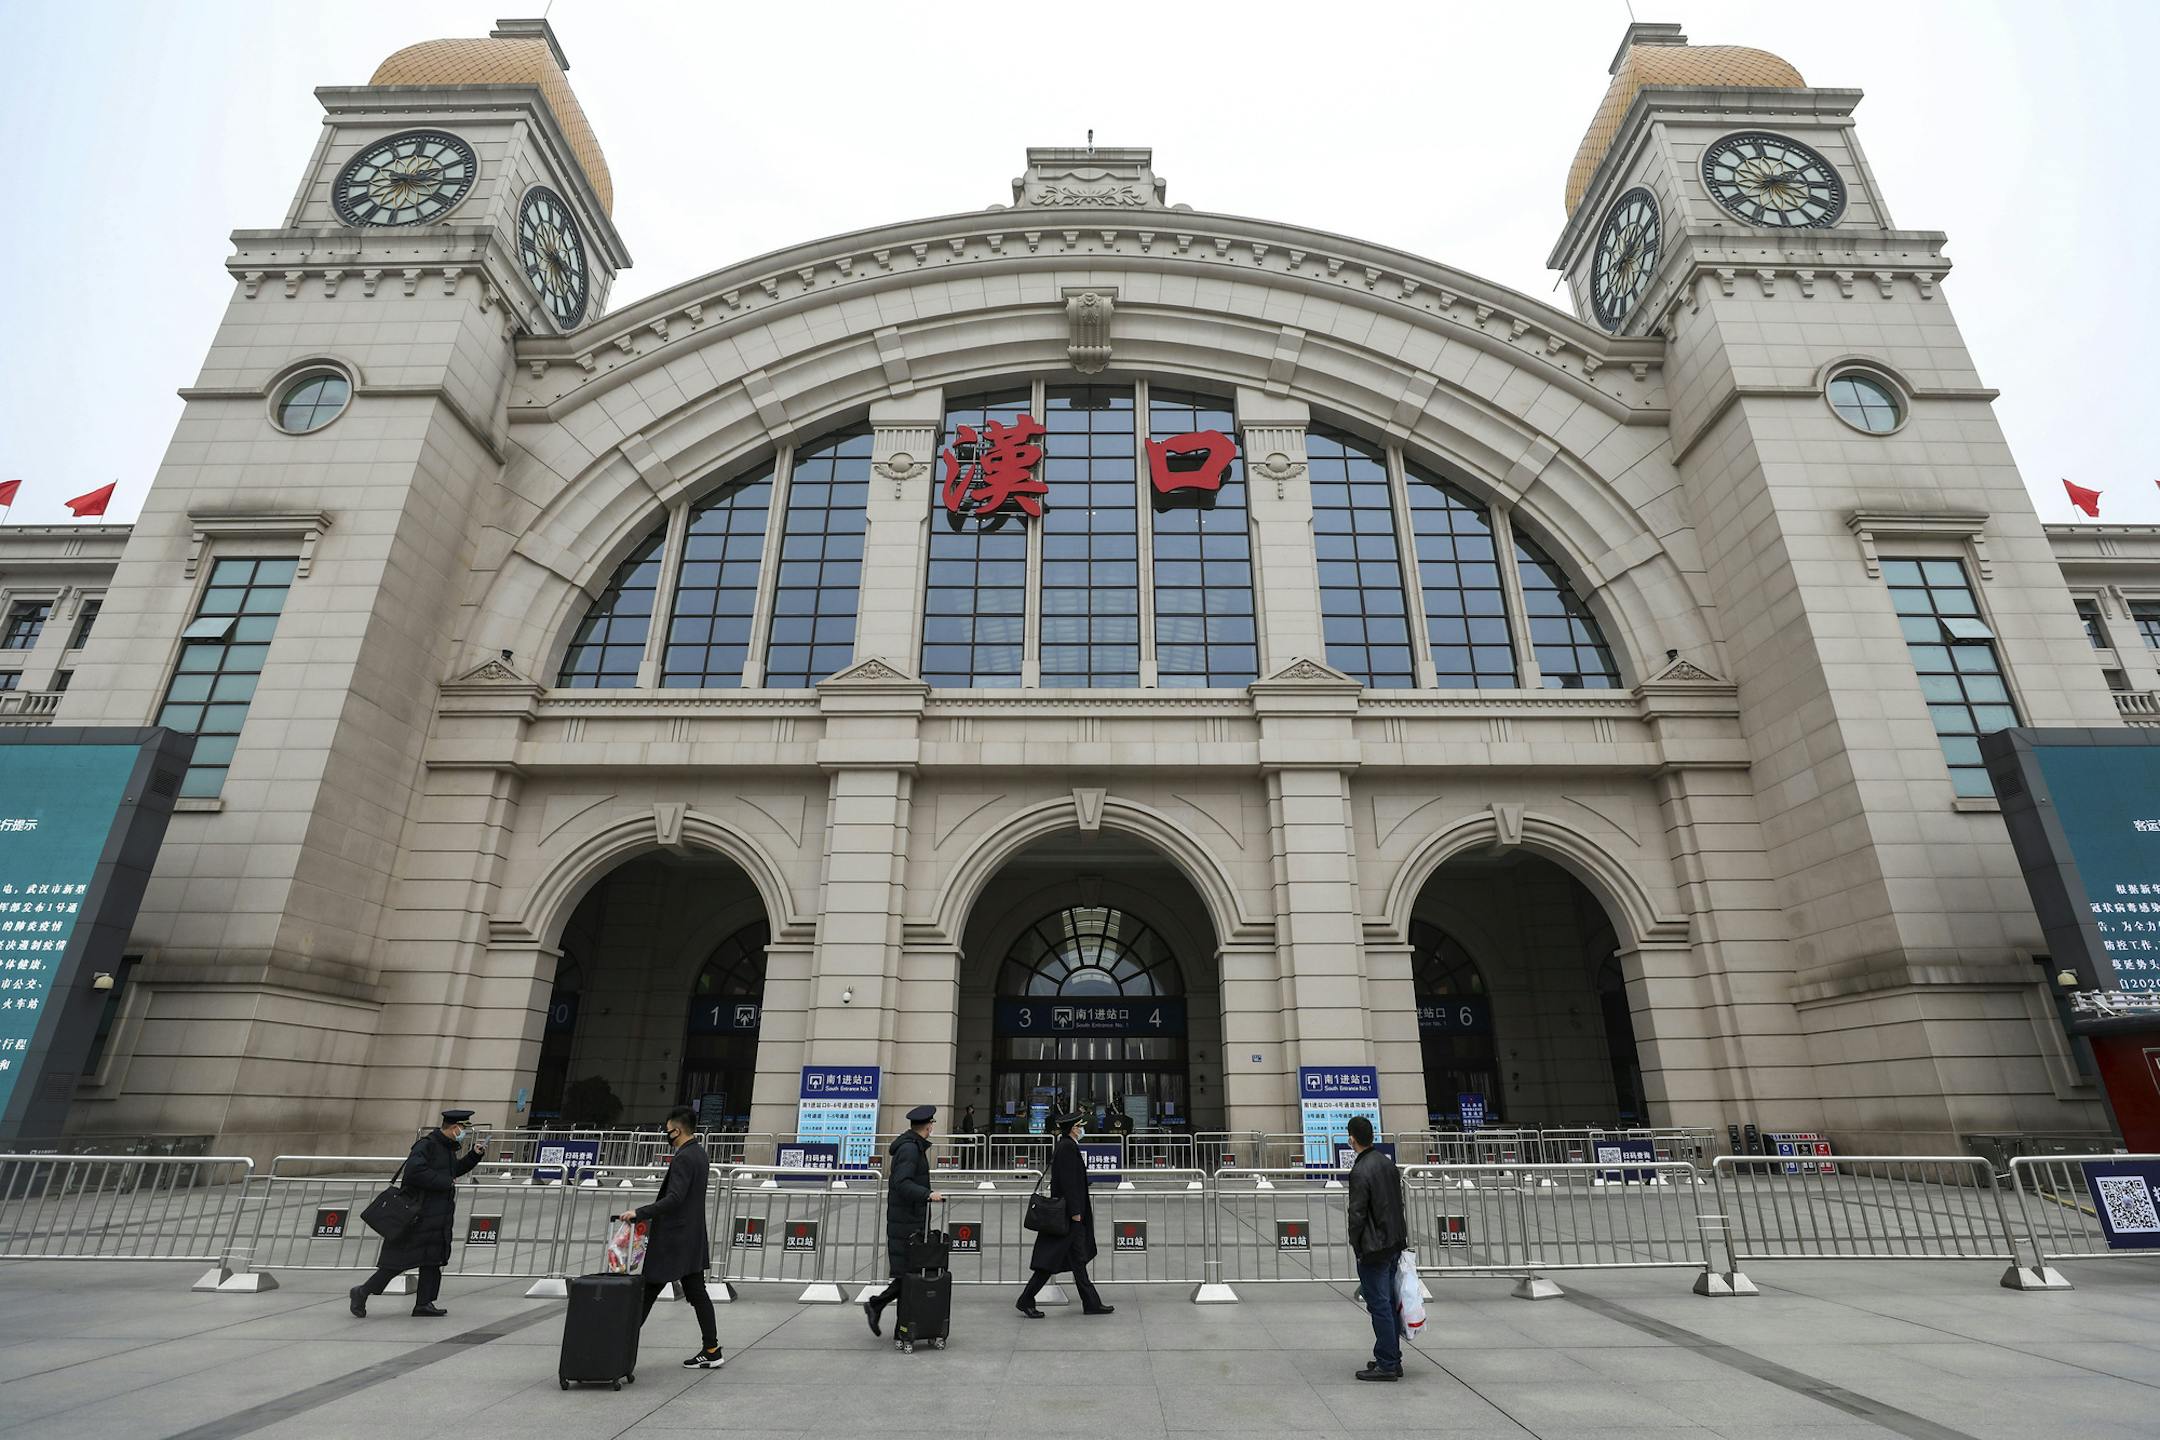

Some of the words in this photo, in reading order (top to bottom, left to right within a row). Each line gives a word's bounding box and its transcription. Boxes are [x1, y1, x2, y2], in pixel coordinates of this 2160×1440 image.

[942, 413, 1238, 518] 漢口
[0, 818, 38, 832] 行提示
[2133, 818, 2160, 832] 客运
[2097, 921, 2160, 932] 告，为全力
[2, 997, 39, 1010] 火车站
[710, 1006, 720, 1026] 1
[1018, 1008, 1032, 1028] 3
[1076, 1008, 1129, 1020] 南1进站口
[1148, 1008, 1162, 1028] 4
[1459, 1006, 1473, 1026] 6
[0, 1038, 28, 1050] 行程
[826, 1074, 873, 1085] 南1进站口
[1324, 1074, 1371, 1085] 南1进站口
[565, 1152, 593, 1160] 扫码查询
[805, 1154, 834, 1162] 扫码查询
[1088, 1155, 1117, 1163] 扫码查询
[470, 1231, 497, 1240] 汉口站
[735, 1233, 762, 1243] 汉口站
[786, 1236, 814, 1246] 汉口站
[1117, 1236, 1144, 1246] 汉口站
[1280, 1236, 1307, 1246] 汉口站
